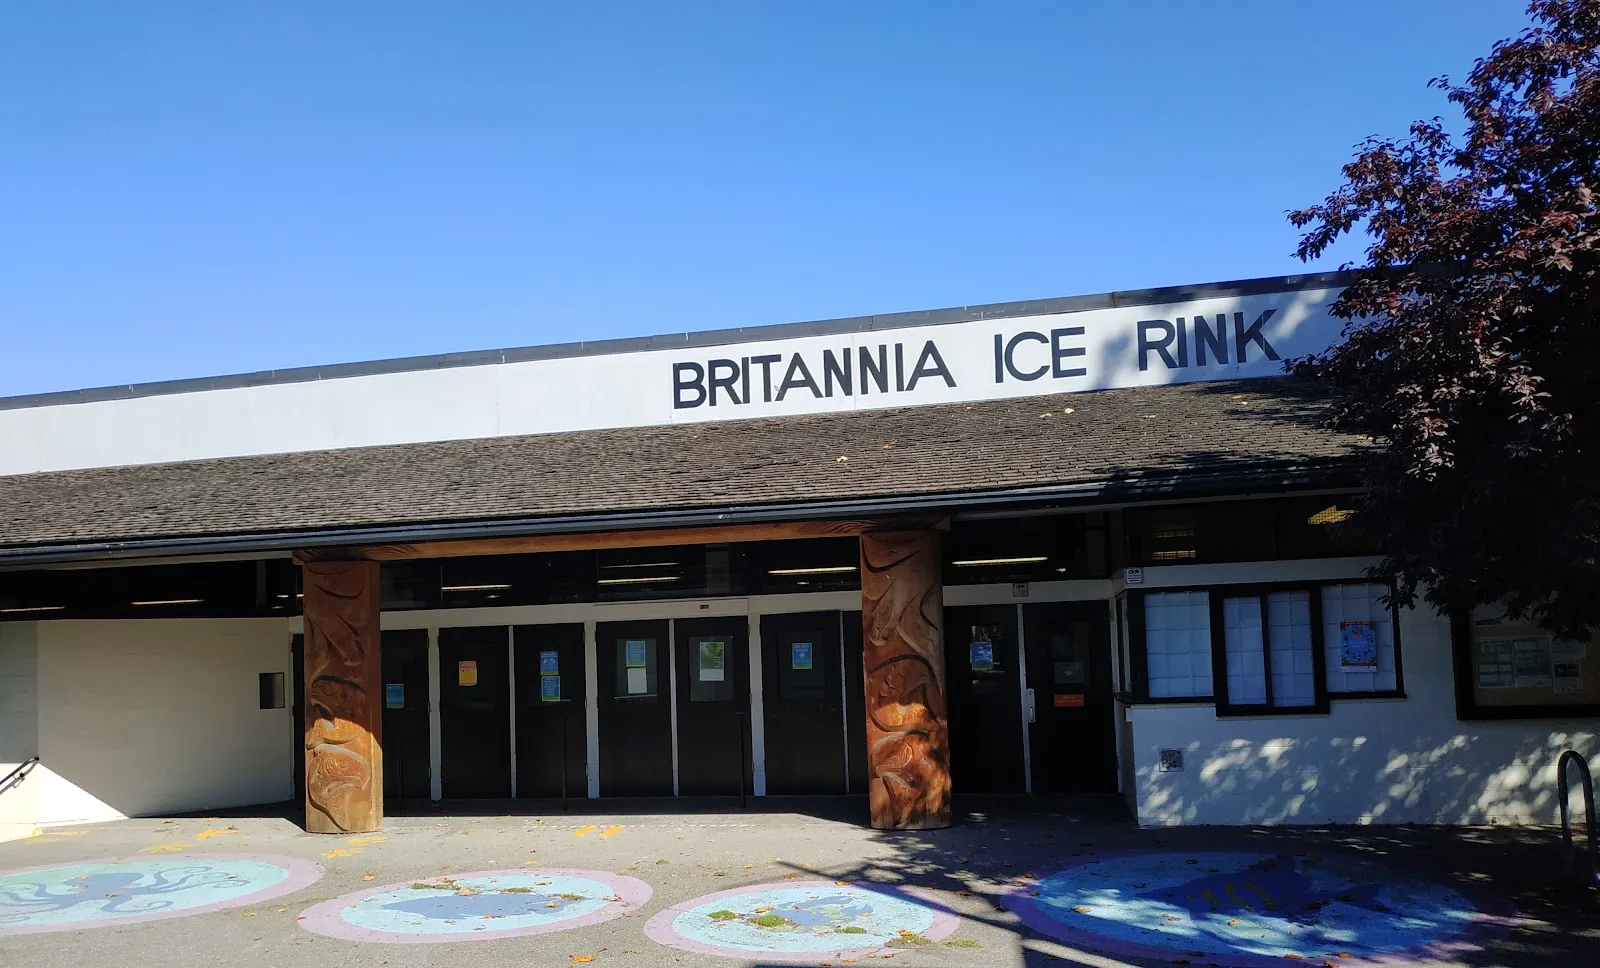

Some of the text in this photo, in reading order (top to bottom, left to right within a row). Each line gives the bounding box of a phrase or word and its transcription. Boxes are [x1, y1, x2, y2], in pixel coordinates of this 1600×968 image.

[673, 309, 1281, 409] BRITANNIA ICE RINK
